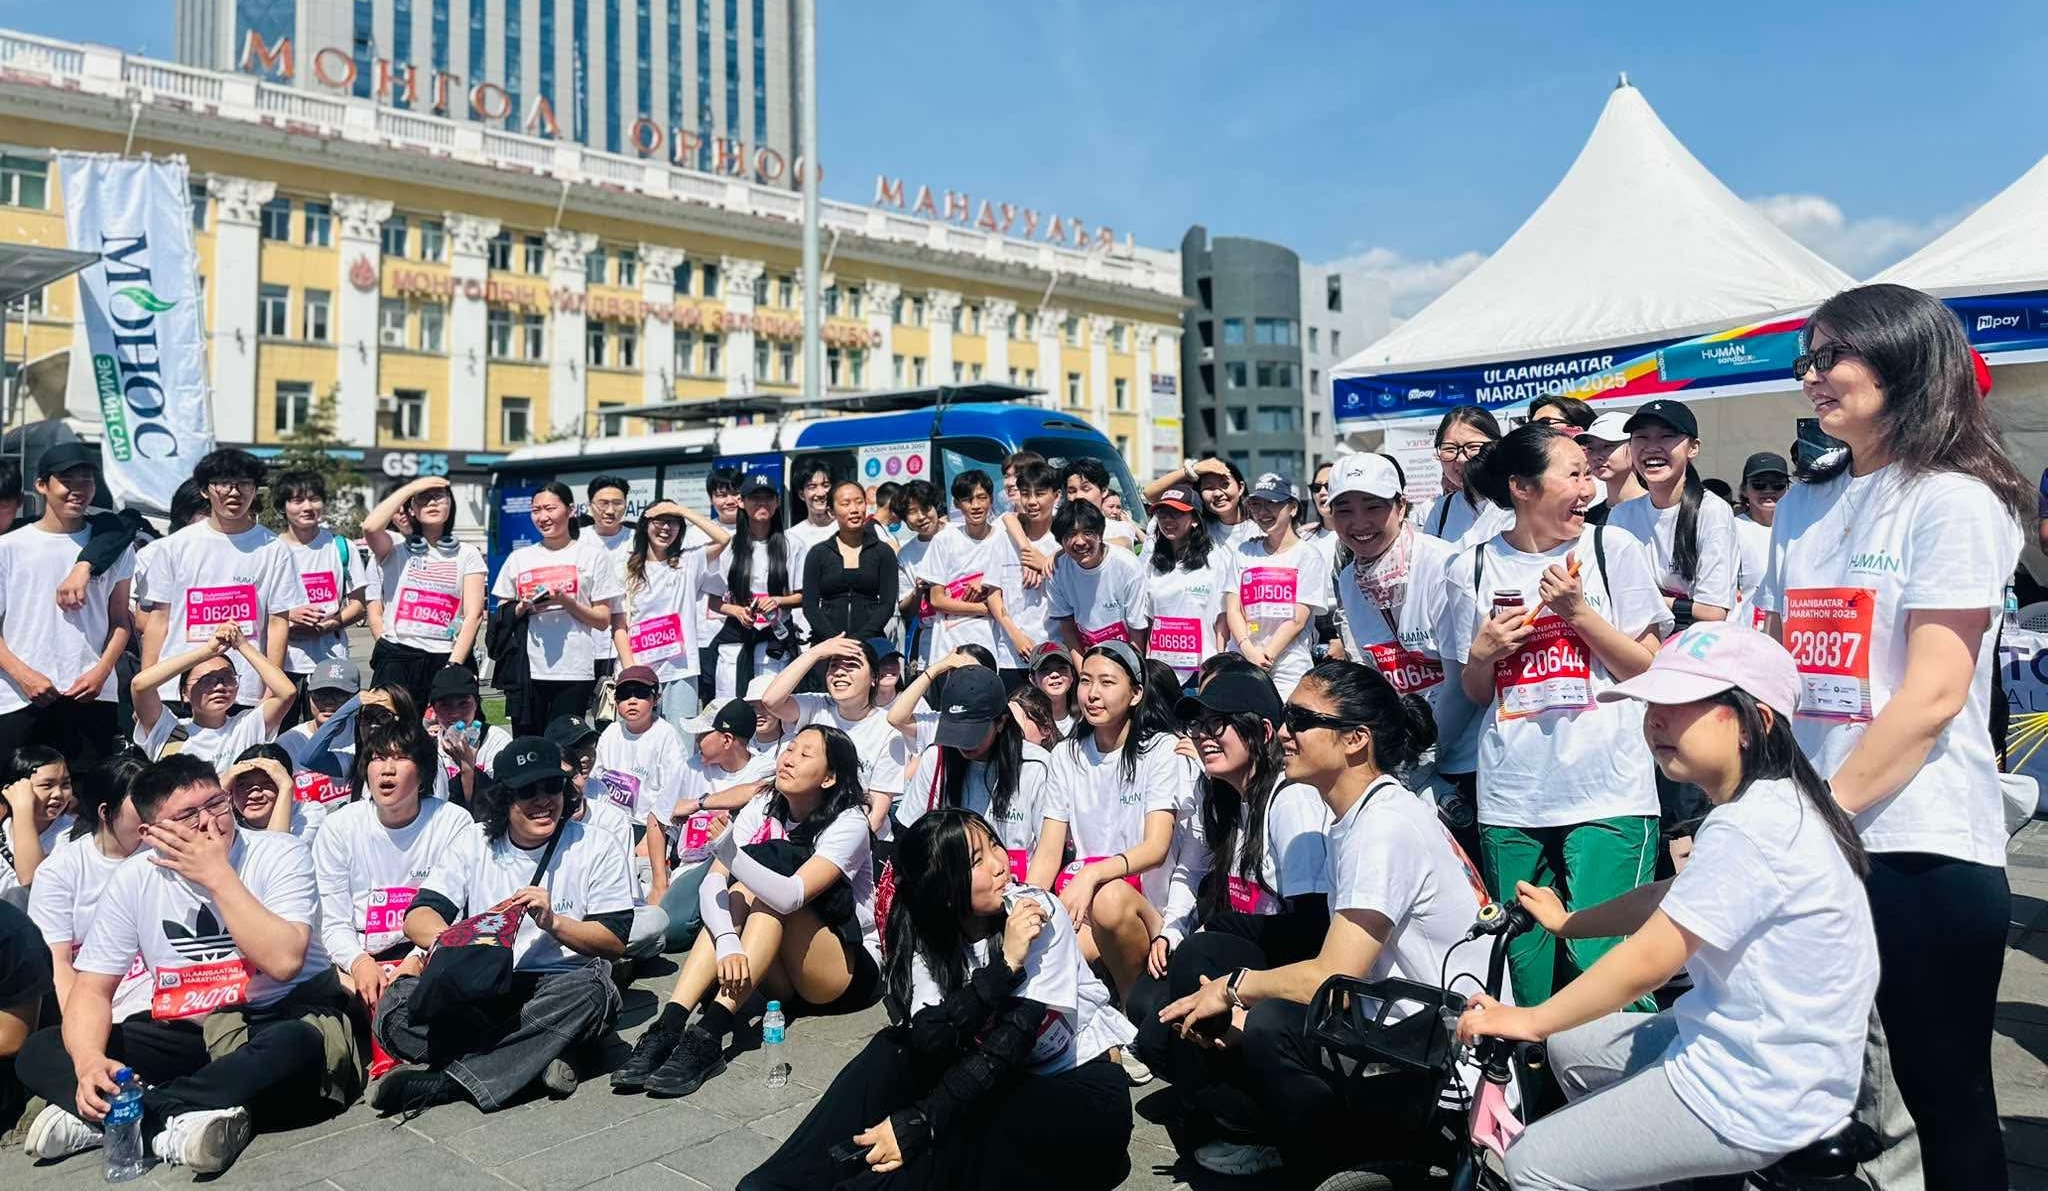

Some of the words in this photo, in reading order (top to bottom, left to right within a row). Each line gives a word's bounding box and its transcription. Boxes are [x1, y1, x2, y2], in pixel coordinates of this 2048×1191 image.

[241, 29, 560, 137] МОНГОЛ
[1484, 355, 1614, 384] ULAANBAATAR
[1476, 378, 1576, 404] MARATHON
[1580, 371, 1628, 393] 2025
[95, 358, 120, 423] ЭМИЙН
[110, 425, 130, 461] САН
[382, 452, 449, 477] GS25
[1253, 584, 1293, 600] 10506
[1790, 598, 1844, 608] ULAANBAATAR
[202, 603, 250, 622] 06209
[1790, 609, 1830, 619] MARATHON
[1832, 609, 1857, 619] 2025
[641, 627, 677, 648] 09248
[1158, 634, 1197, 649] 06683
[1790, 630, 1862, 668] 23837
[1520, 645, 1586, 679] 20644
[162, 993, 171, 1004] 5
[178, 982, 241, 1013] 24076
